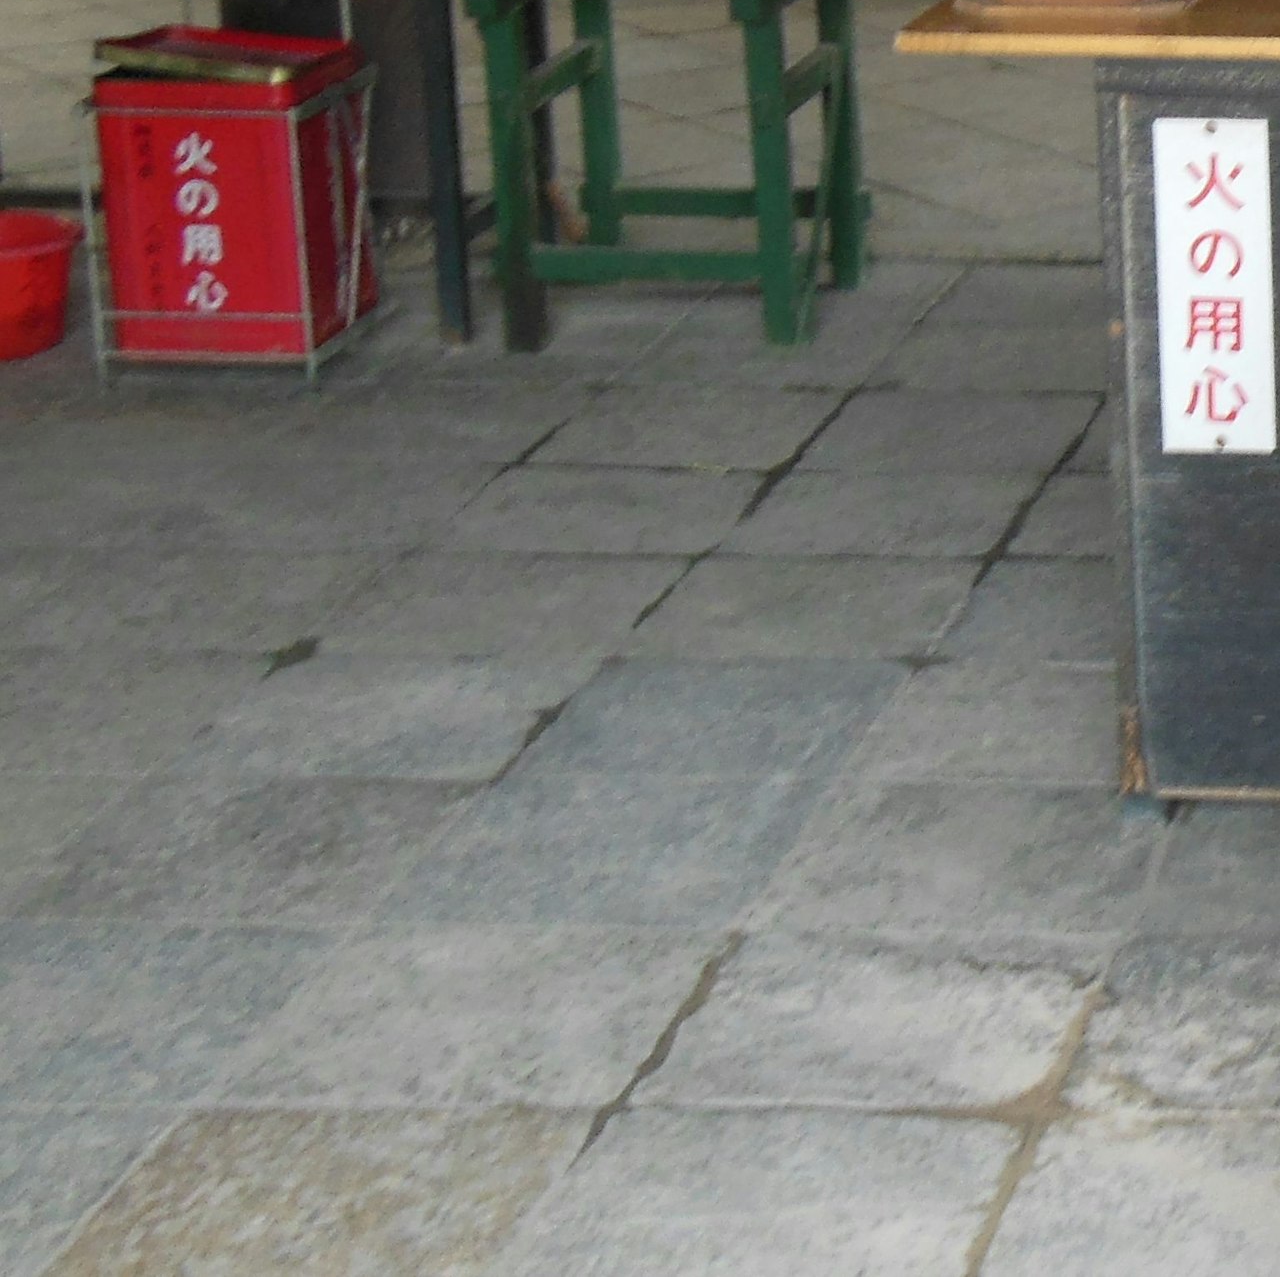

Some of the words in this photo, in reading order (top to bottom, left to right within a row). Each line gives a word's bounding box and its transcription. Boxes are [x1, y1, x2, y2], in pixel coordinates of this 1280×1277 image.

[171, 130, 230, 315] 火の用心
[1182, 151, 1249, 425] 火の用心
